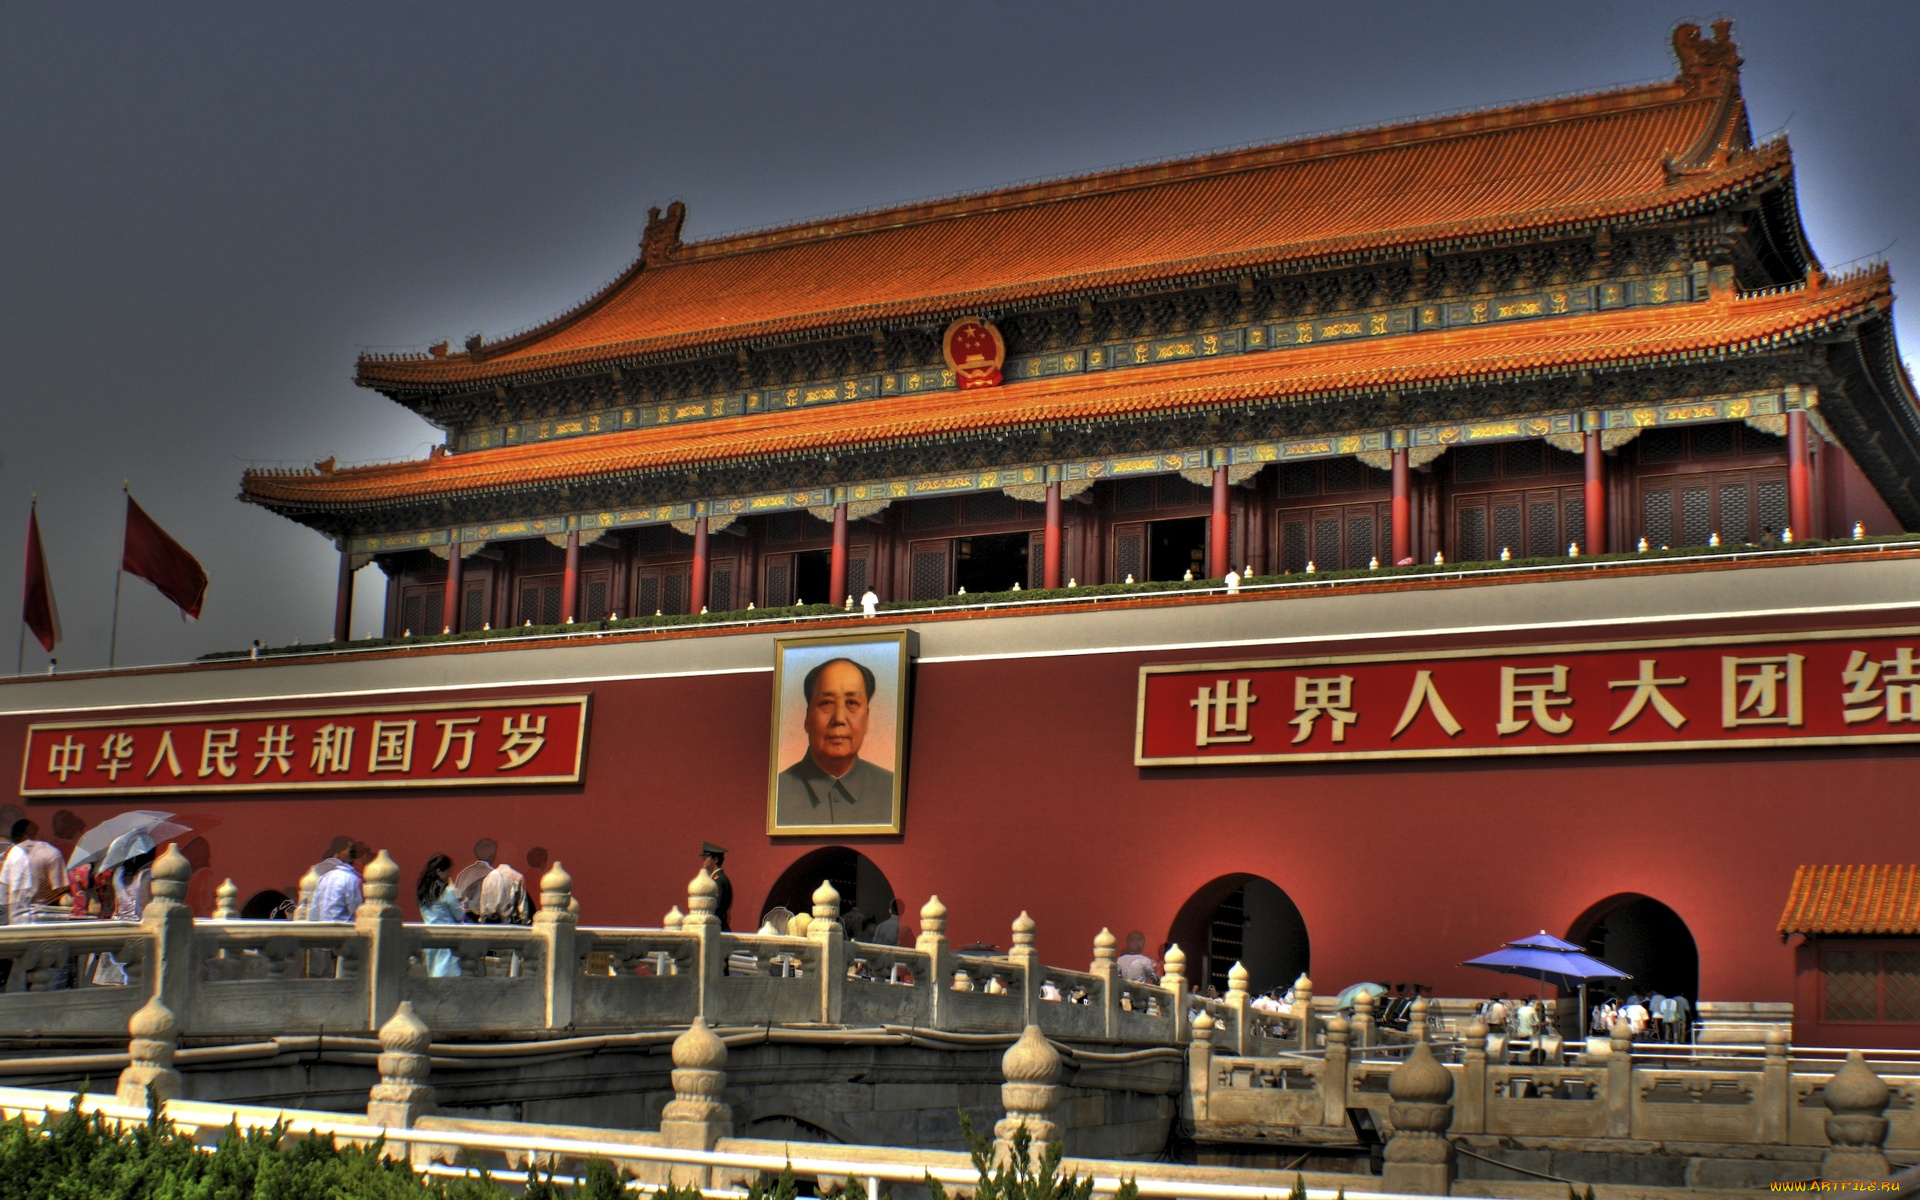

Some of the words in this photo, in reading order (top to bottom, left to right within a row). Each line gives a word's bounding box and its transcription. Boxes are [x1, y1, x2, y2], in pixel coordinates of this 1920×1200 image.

[1190, 647, 1920, 747] 世界人民大团结
[47, 713, 548, 783] 中华人民共和国万岁
